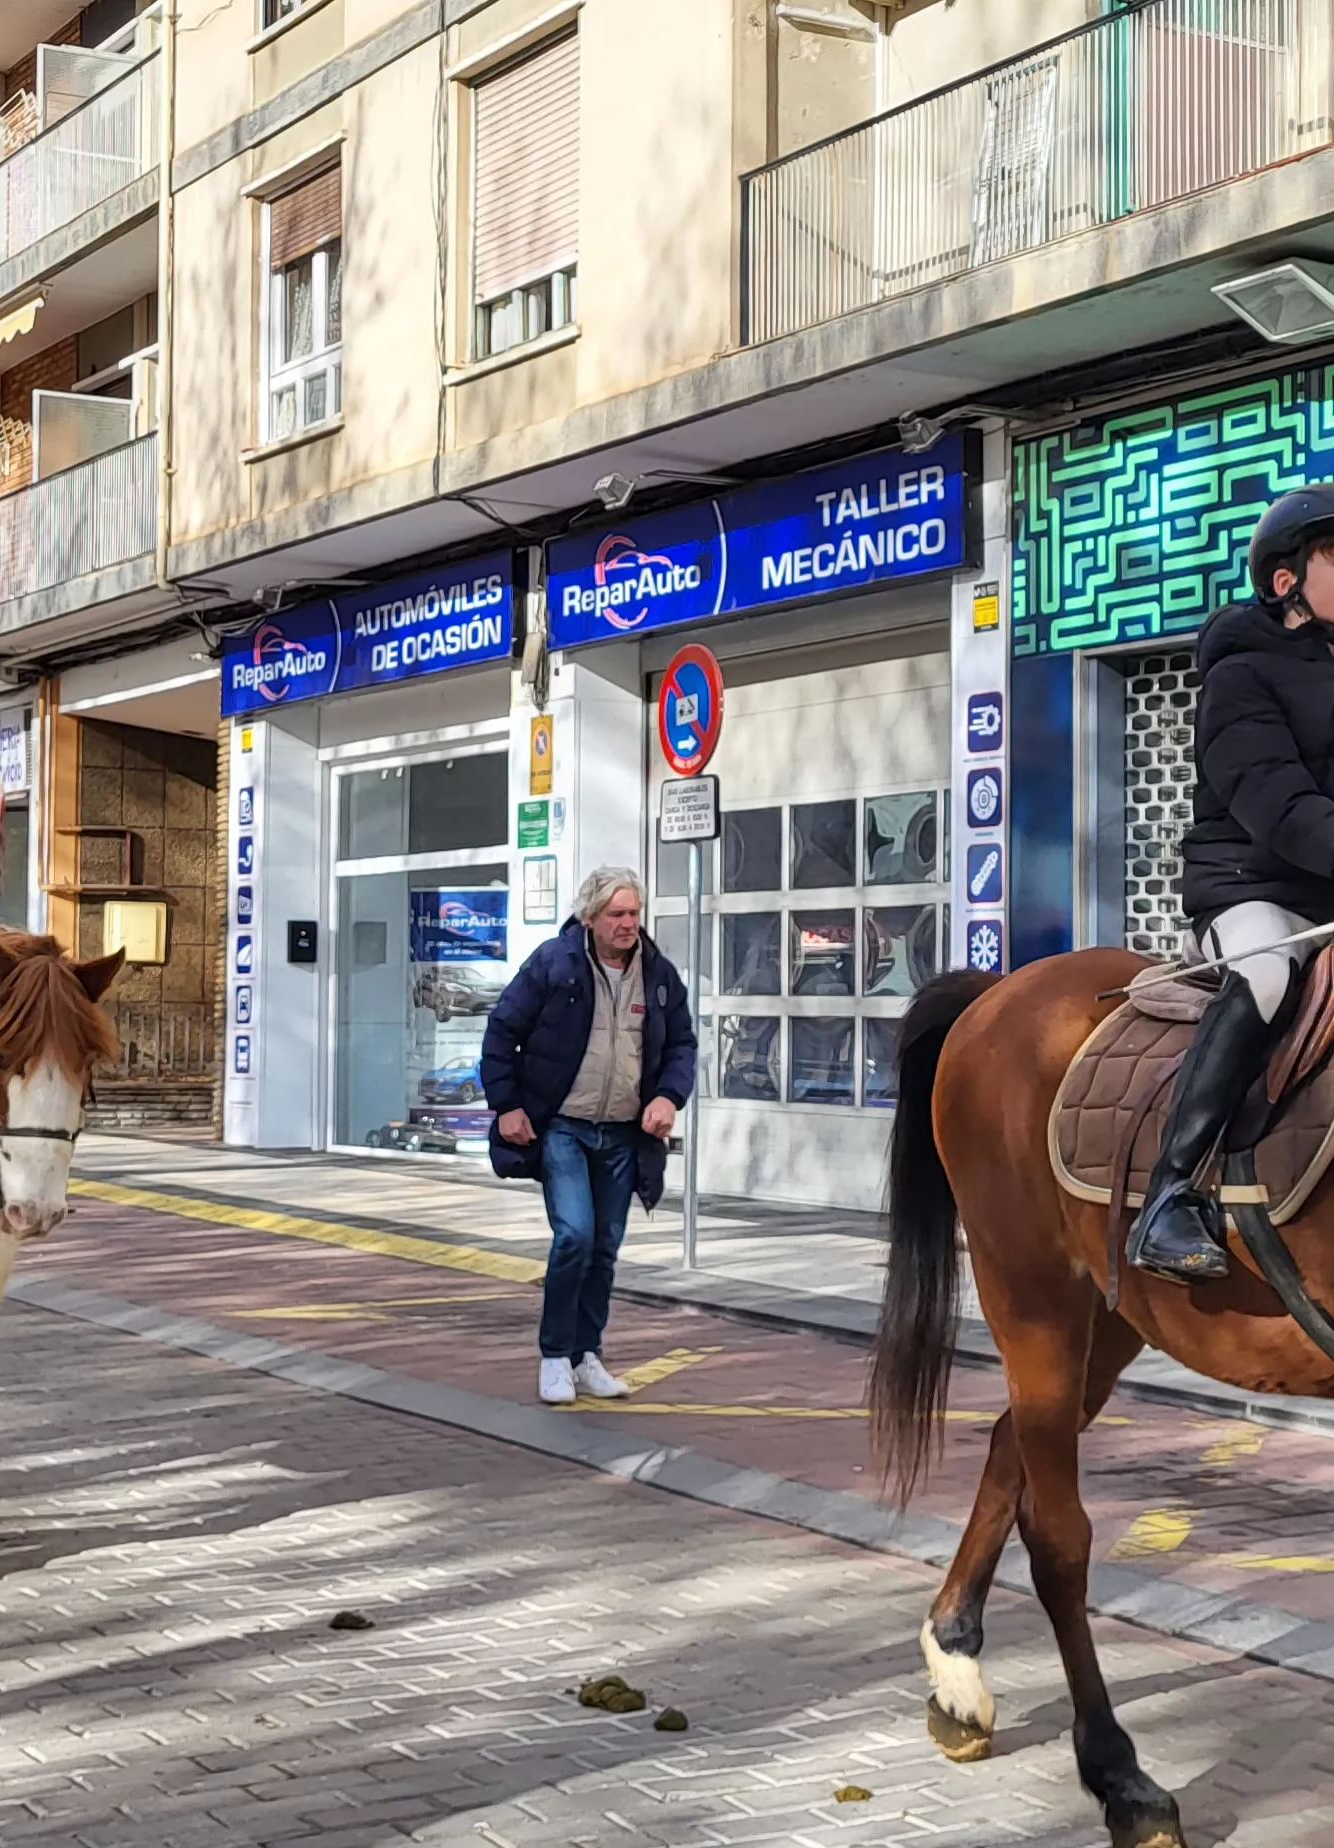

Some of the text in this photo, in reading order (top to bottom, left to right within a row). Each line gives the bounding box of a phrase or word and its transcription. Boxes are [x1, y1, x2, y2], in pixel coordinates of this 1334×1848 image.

[816, 465, 945, 528] TALLER
[761, 518, 946, 591] MECÁNICO
[354, 575, 503, 638] AUTOMÓVILES
[562, 563, 701, 618] ReparAuto
[232, 649, 326, 692] ReparAuto
[371, 611, 502, 672] DE OCASIÓN
